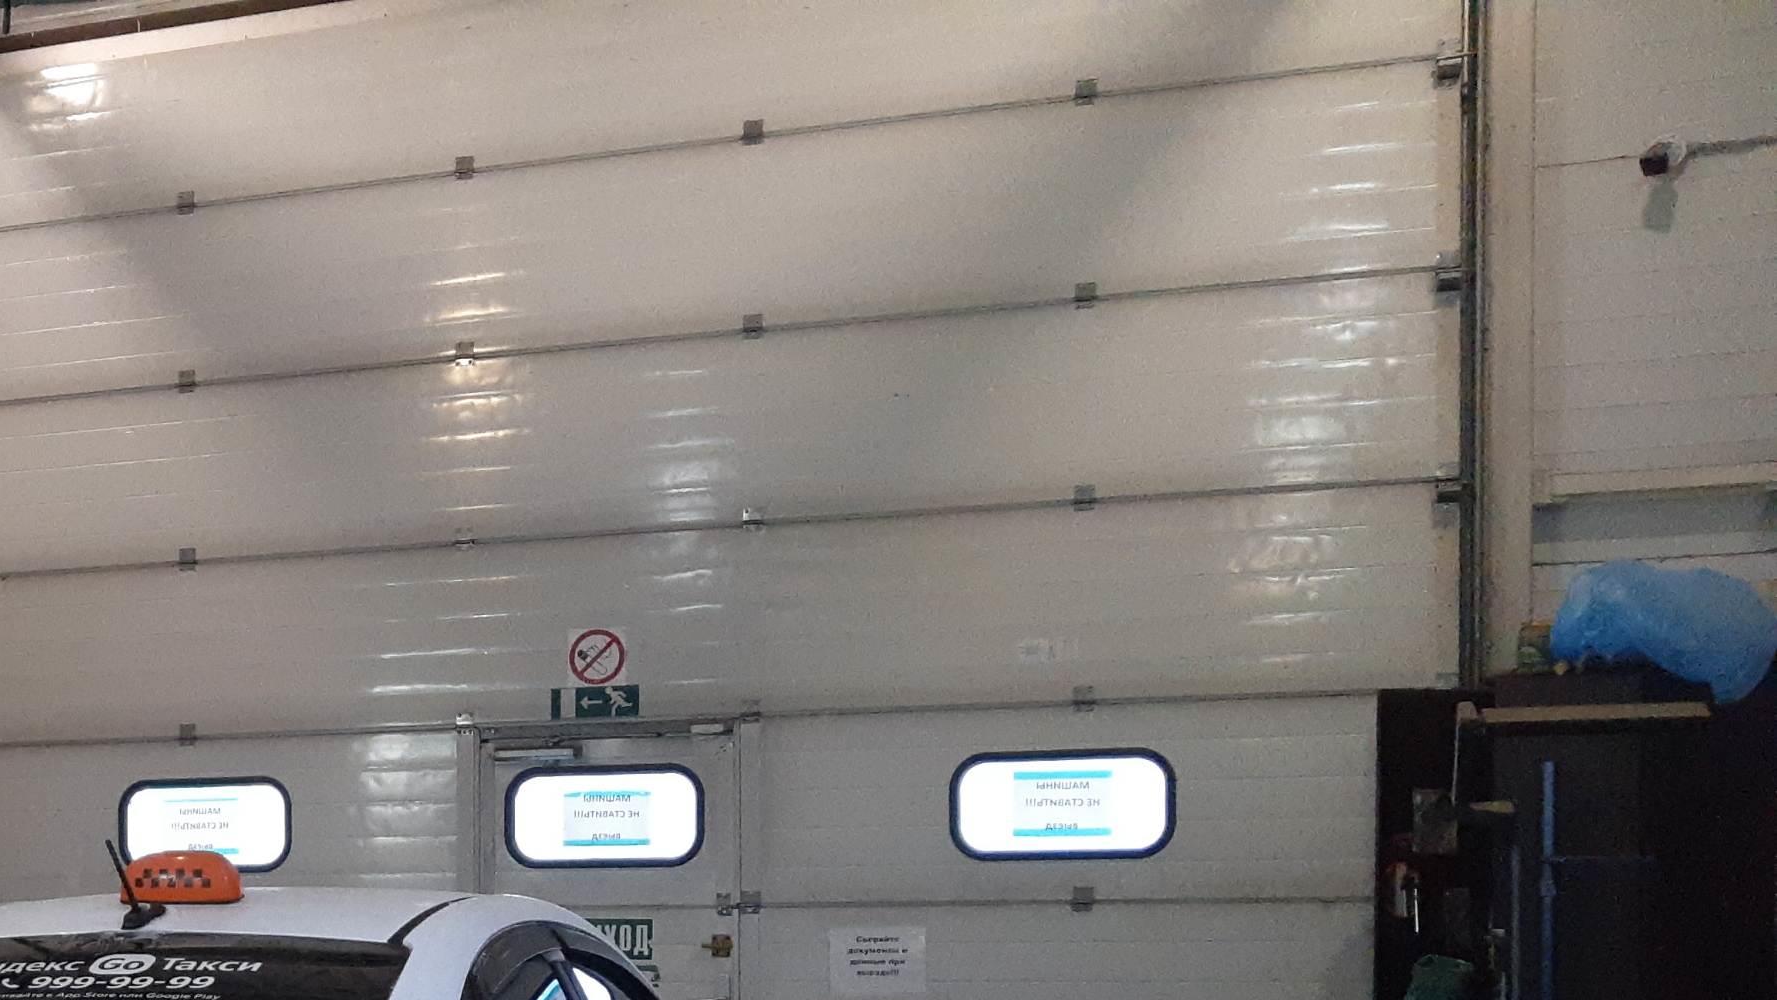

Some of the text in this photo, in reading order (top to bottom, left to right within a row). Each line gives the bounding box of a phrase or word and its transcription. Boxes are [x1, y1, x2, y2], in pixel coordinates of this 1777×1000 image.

[595, 924, 650, 956] ХОД
[162, 958, 263, 972] Такси
[28, 976, 216, 989] 999-99-99
[146, 992, 192, 1000] Google
[193, 992, 221, 1000] Play
